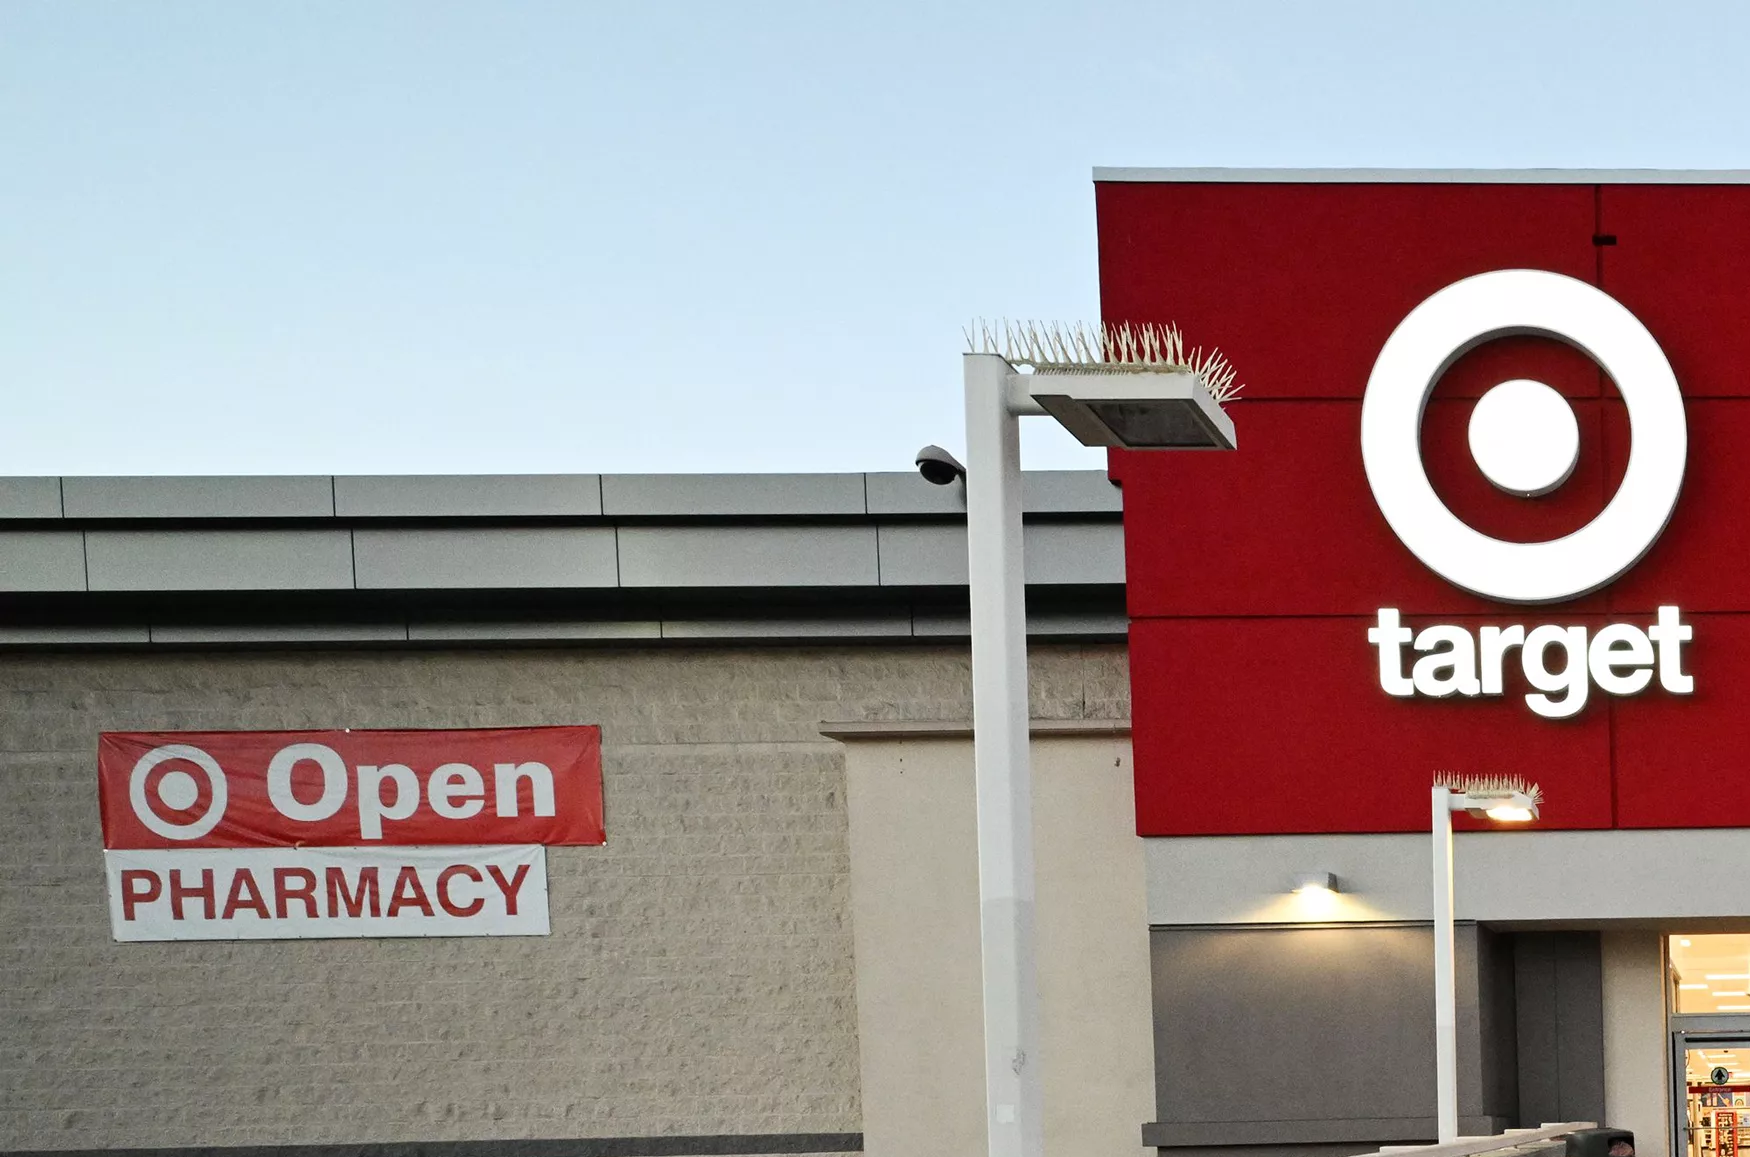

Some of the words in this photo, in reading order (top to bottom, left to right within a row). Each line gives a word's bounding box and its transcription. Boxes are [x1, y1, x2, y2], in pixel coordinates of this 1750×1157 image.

[1367, 605, 1694, 718] target
[266, 742, 556, 840] Open
[121, 864, 531, 921] PHARMACY
